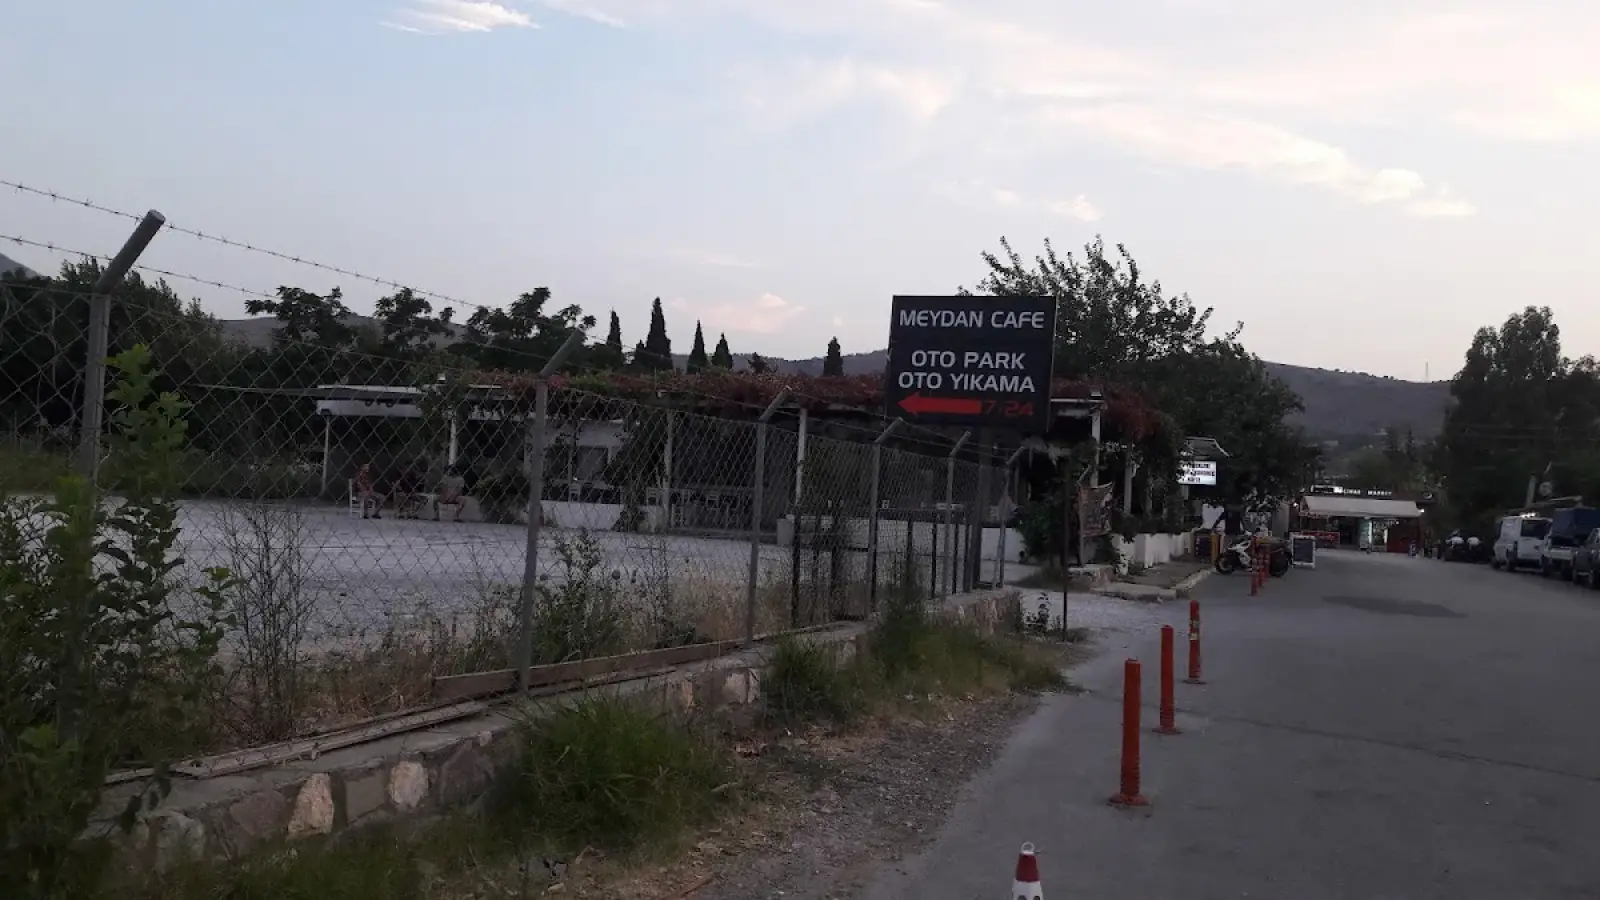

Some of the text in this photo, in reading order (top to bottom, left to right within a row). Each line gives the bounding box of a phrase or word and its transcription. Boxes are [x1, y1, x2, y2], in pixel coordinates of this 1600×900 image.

[899, 309, 1045, 329] MEYDAN CAFE
[911, 350, 1026, 370] OTO PARK
[898, 371, 1036, 393] OTO YIKAMA
